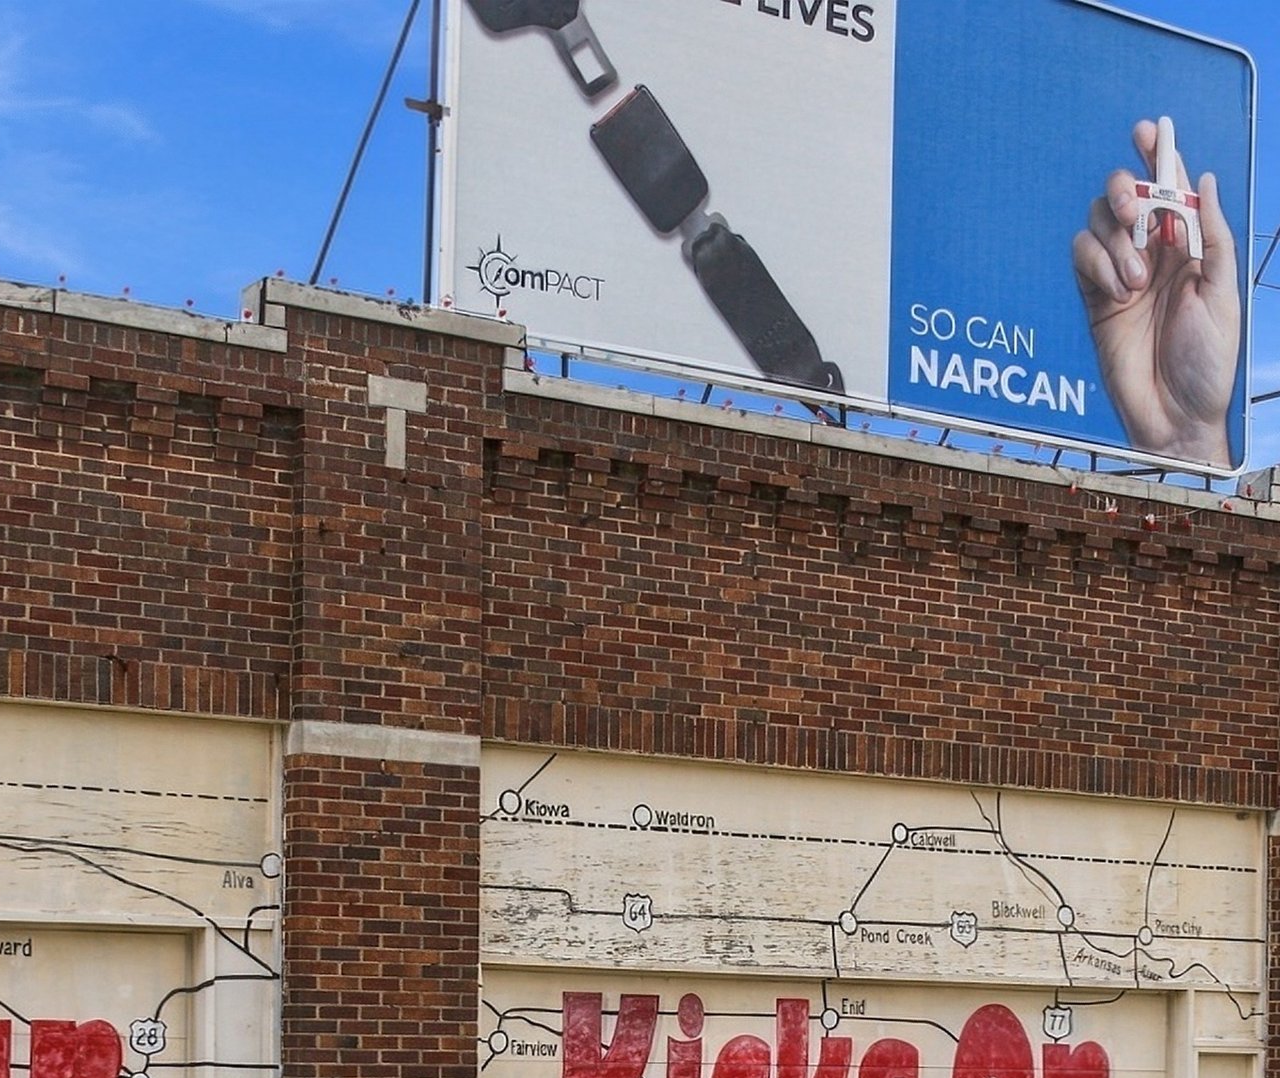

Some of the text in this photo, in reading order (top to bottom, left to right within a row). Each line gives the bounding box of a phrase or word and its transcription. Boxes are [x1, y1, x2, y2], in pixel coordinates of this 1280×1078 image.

[910, 303, 1035, 359] SO CAN
[524, 799, 570, 818] Kiowa
[655, 810, 716, 829] Waldron
[910, 832, 956, 848] Caldwell
[221, 869, 255, 891] Alva
[628, 901, 648, 923] 64
[991, 900, 1046, 921] Blackwell
[860, 928, 934, 947] Pond Creek
[841, 997, 866, 1016] Enid
[1050, 1013, 1067, 1031] 77
[510, 1040, 559, 1058] Fairview
